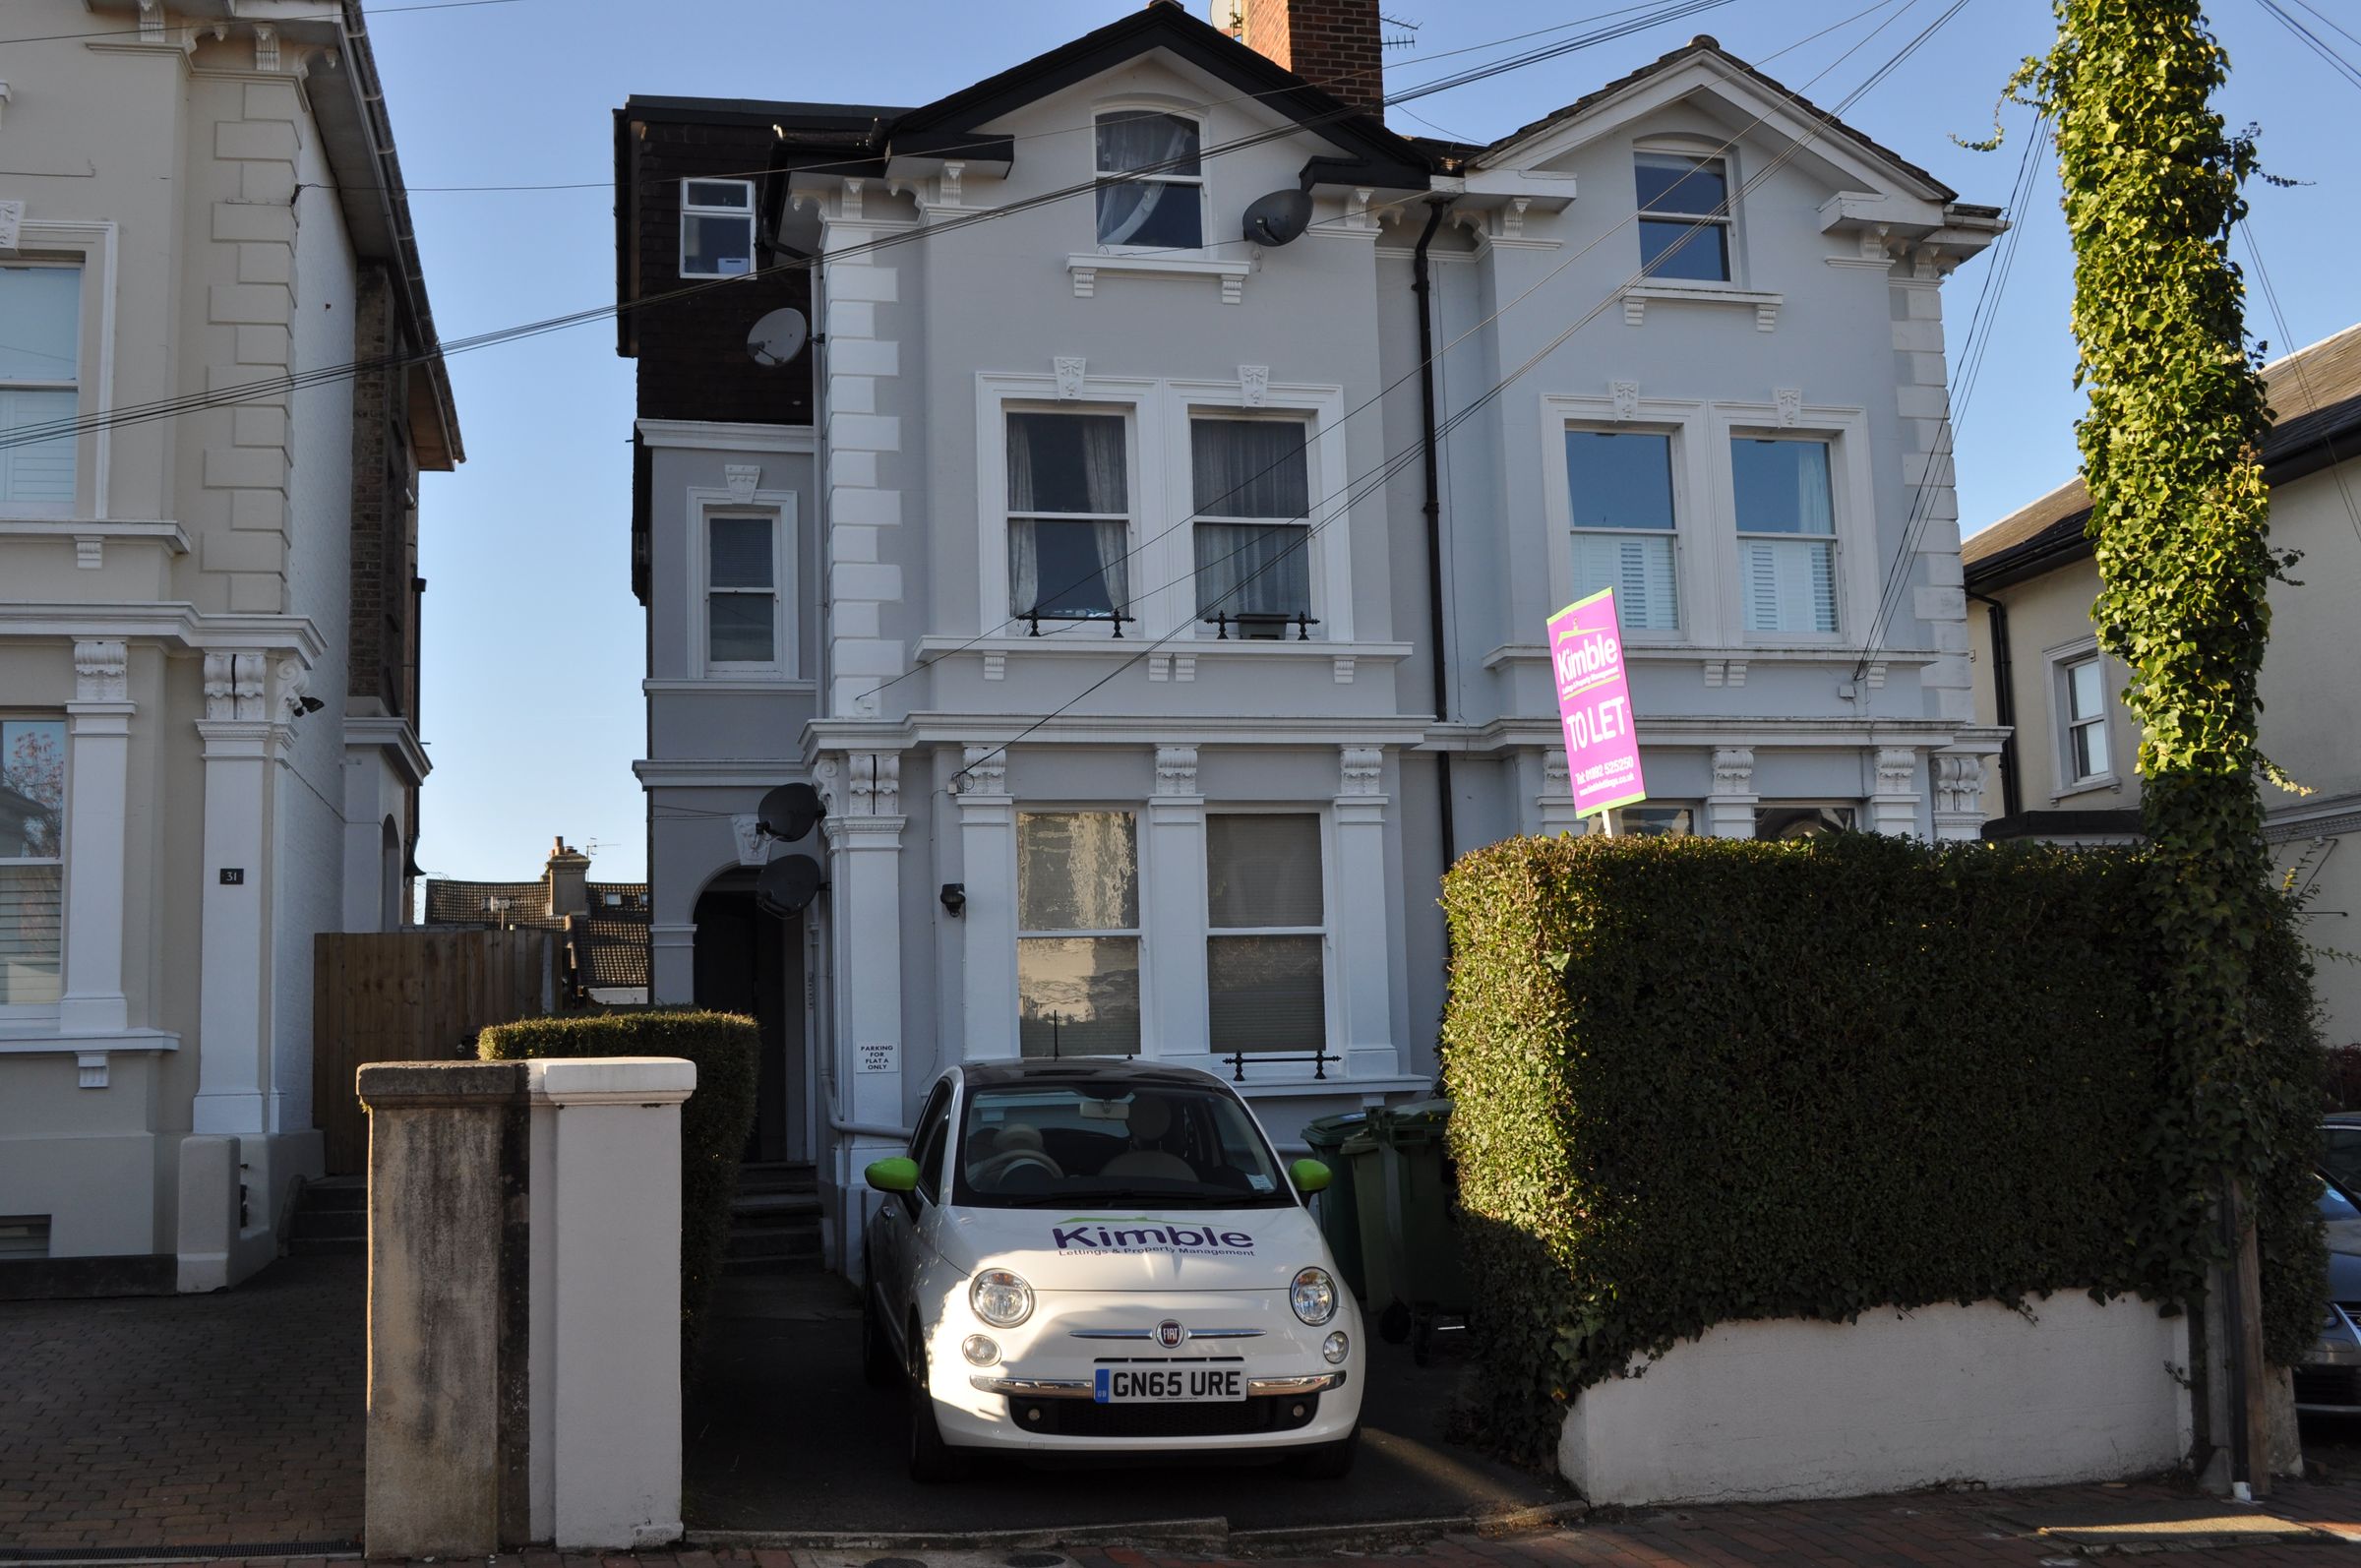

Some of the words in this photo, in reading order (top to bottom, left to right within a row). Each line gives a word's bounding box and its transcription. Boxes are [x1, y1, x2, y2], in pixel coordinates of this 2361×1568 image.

[1556, 633, 1618, 685] Kimble
[1566, 710, 1588, 753] TO
[1587, 695, 1625, 744] LET
[1604, 755, 1634, 775] 525250
[226, 872, 237, 881] 31
[1052, 1226, 1254, 1249] Kimble
[1123, 1245, 1176, 1254] Property
[1179, 1247, 1255, 1256] Management
[1163, 1327, 1179, 1341] FIAT
[1113, 1371, 1182, 1397] GN65
[1190, 1370, 1241, 1396] URE
